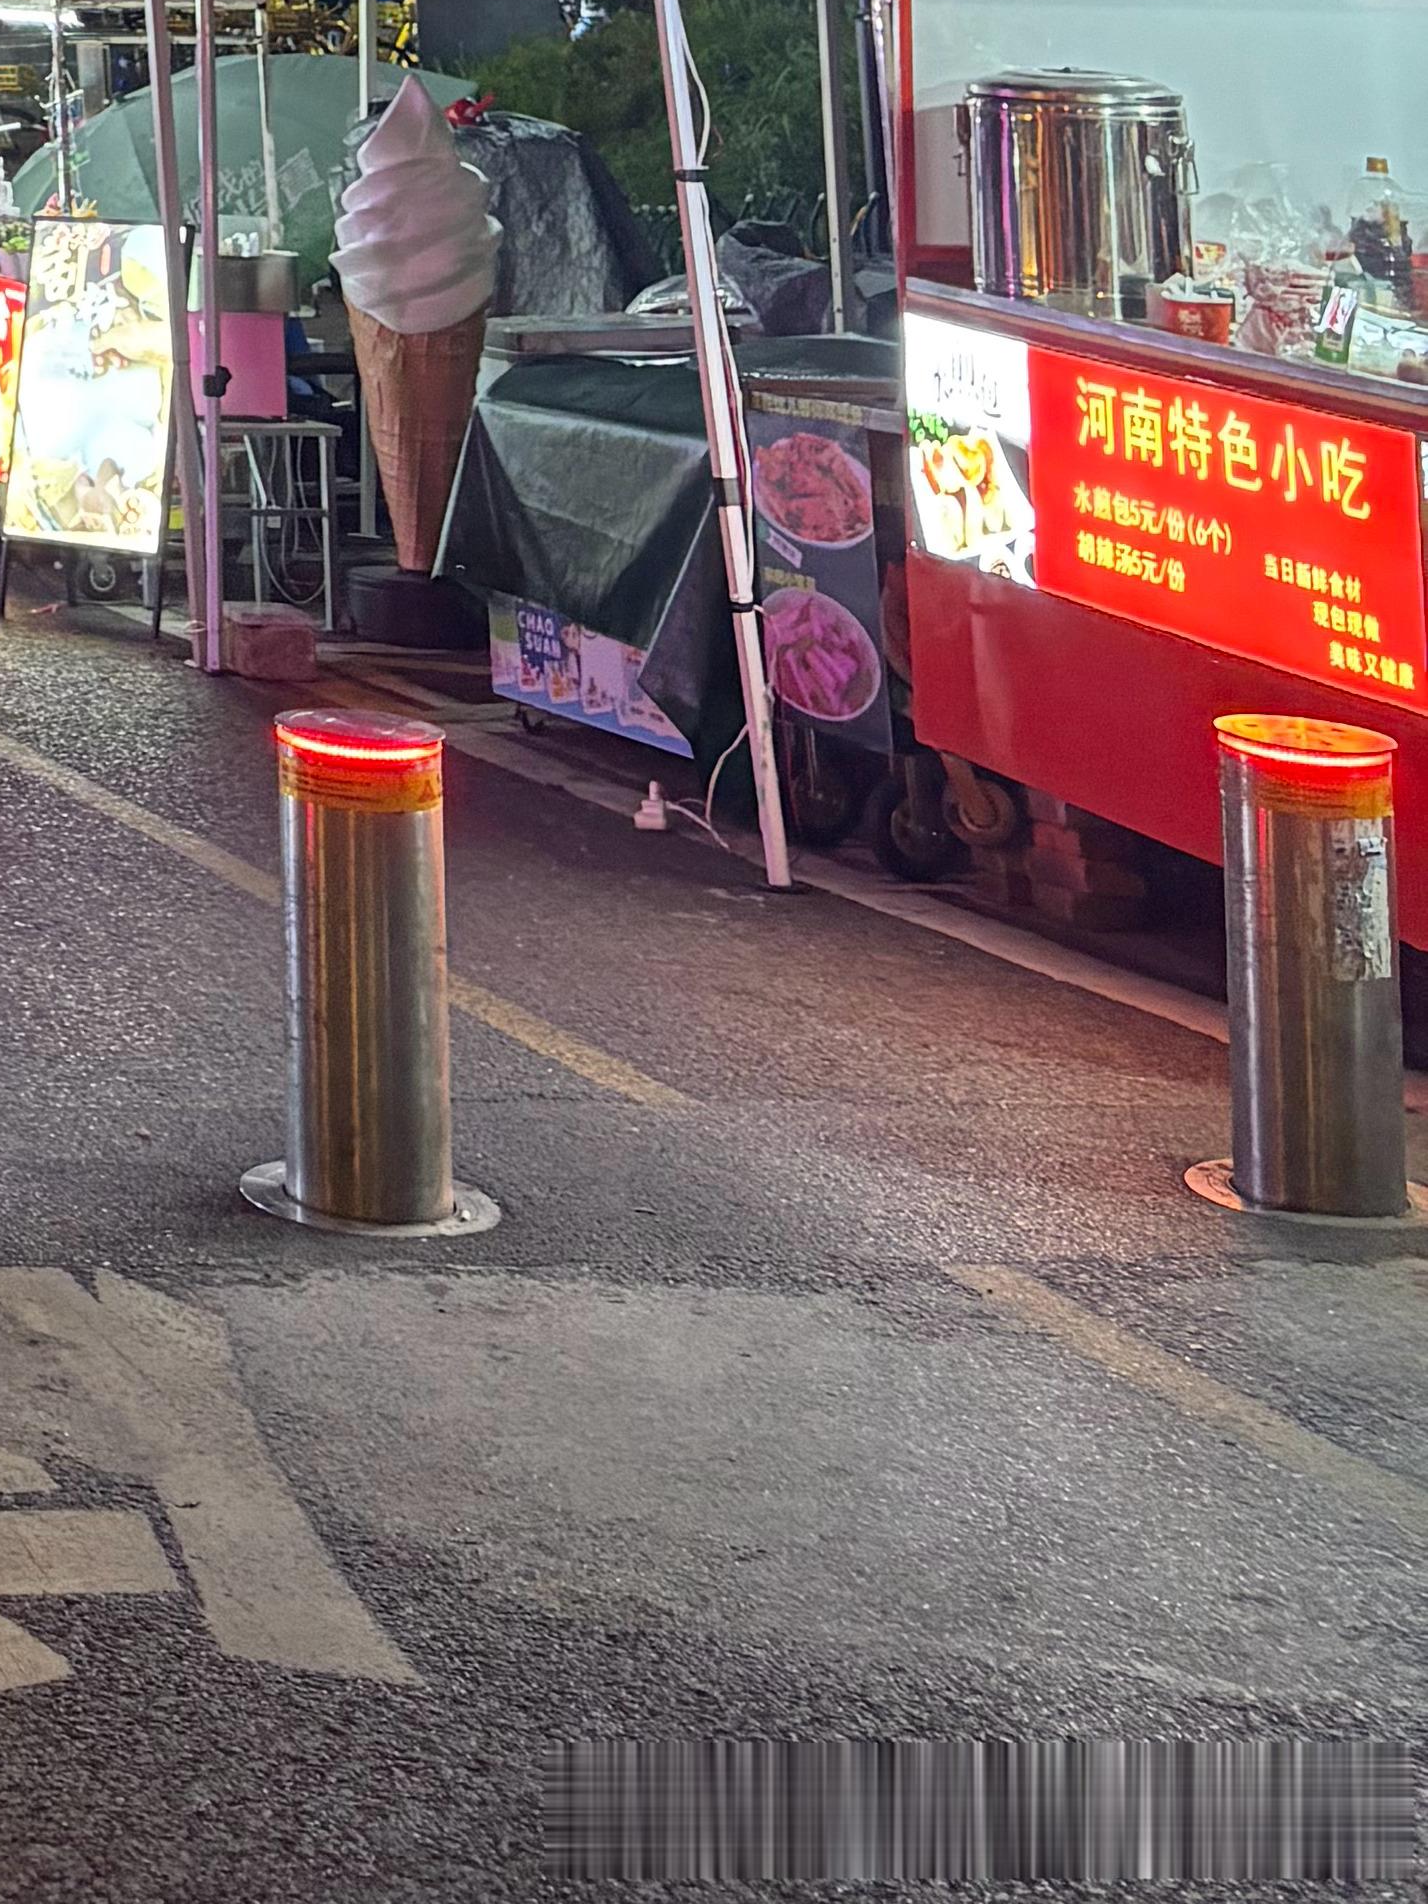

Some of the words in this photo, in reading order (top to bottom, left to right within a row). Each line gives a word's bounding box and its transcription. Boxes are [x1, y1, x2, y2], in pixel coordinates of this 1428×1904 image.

[1075, 375, 1373, 521] 河南特色小吃
[1263, 553, 1362, 604] 当日新鲜食材
[524, 631, 563, 660] SUAN
[1328, 640, 1416, 690] 美味又健康
